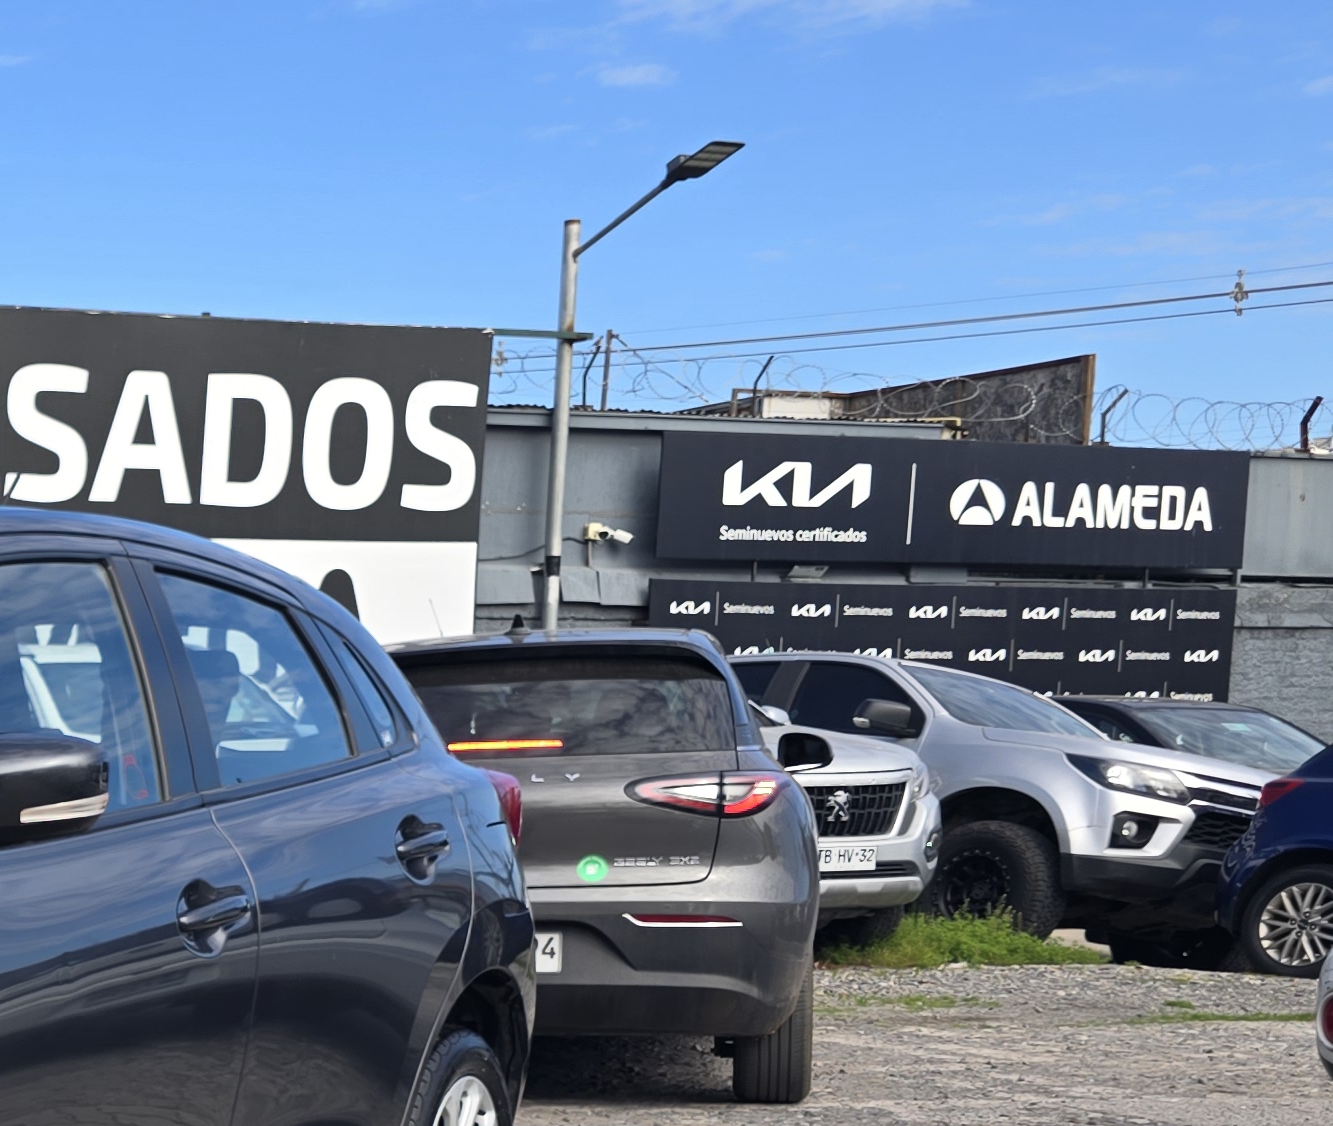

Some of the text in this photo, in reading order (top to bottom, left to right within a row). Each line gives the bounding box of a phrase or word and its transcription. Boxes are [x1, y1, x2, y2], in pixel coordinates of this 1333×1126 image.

[722, 459, 873, 509] KIA
[1010, 480, 1213, 532] ALAMEDA
[718, 524, 868, 543] Seminuevos certificados
